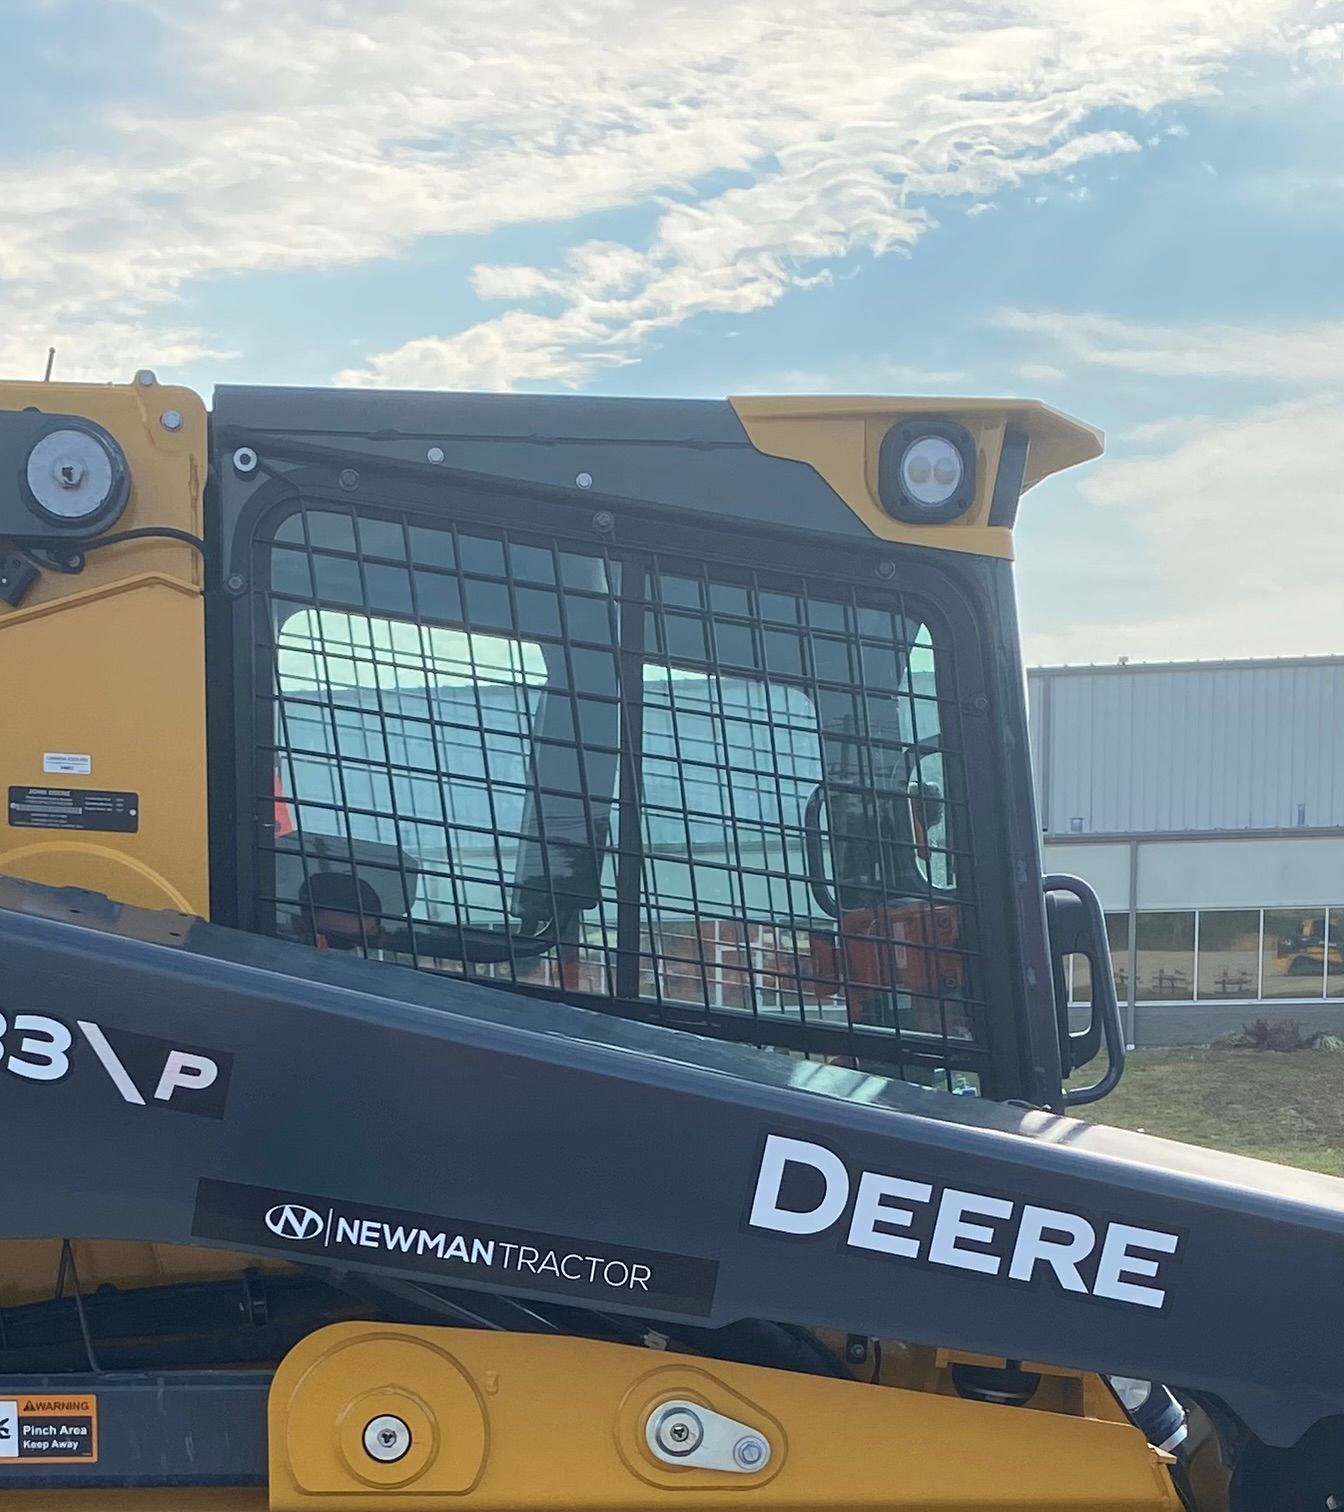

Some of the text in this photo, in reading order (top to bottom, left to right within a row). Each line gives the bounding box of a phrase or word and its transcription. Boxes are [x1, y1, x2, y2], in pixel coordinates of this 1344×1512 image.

[748, 1133, 1180, 1310] DEERE
[35, 1401, 89, 1412] WARNING
[23, 1425, 88, 1436] Pinch Area
[23, 1439, 79, 1451] Keep Away
